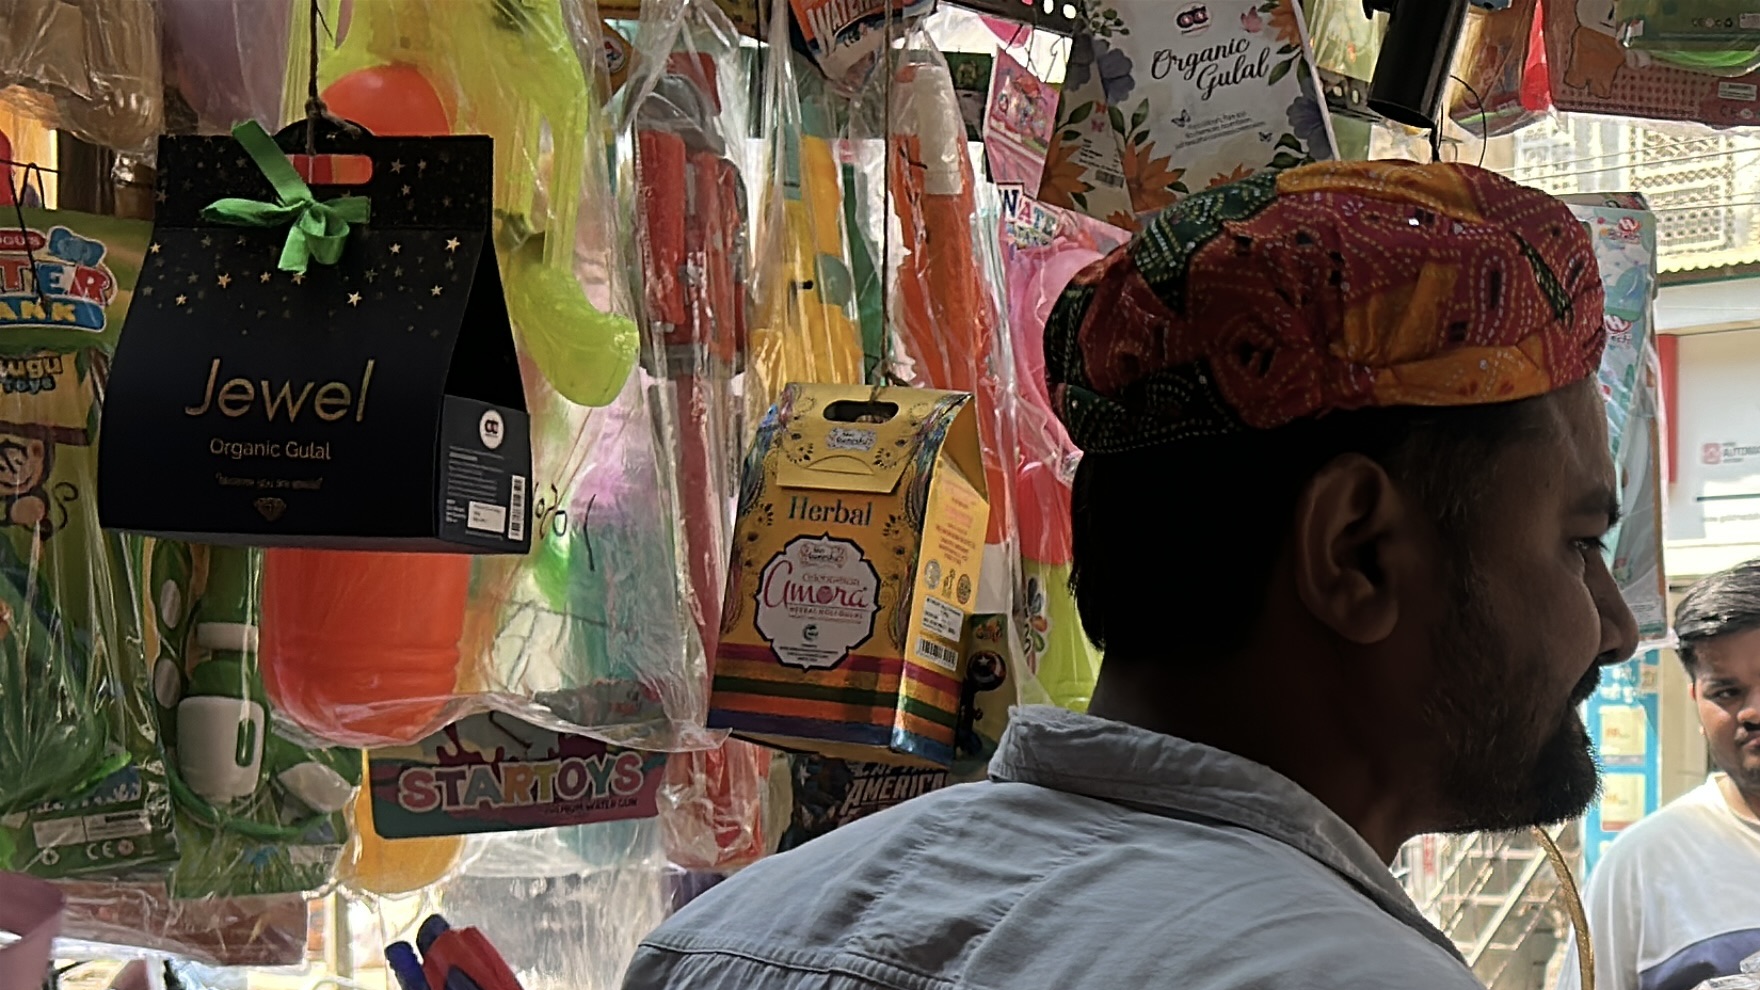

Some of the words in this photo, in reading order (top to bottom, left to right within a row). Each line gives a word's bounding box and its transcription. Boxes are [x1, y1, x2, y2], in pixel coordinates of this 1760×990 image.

[1151, 38, 1250, 80] Organic
[1196, 47, 1270, 101] Gulal
[185, 357, 376, 424] Jewel
[209, 437, 281, 461] Organic
[285, 440, 332, 461] Gulal
[787, 495, 872, 527] Herbal
[399, 751, 645, 812] STARTOYS
